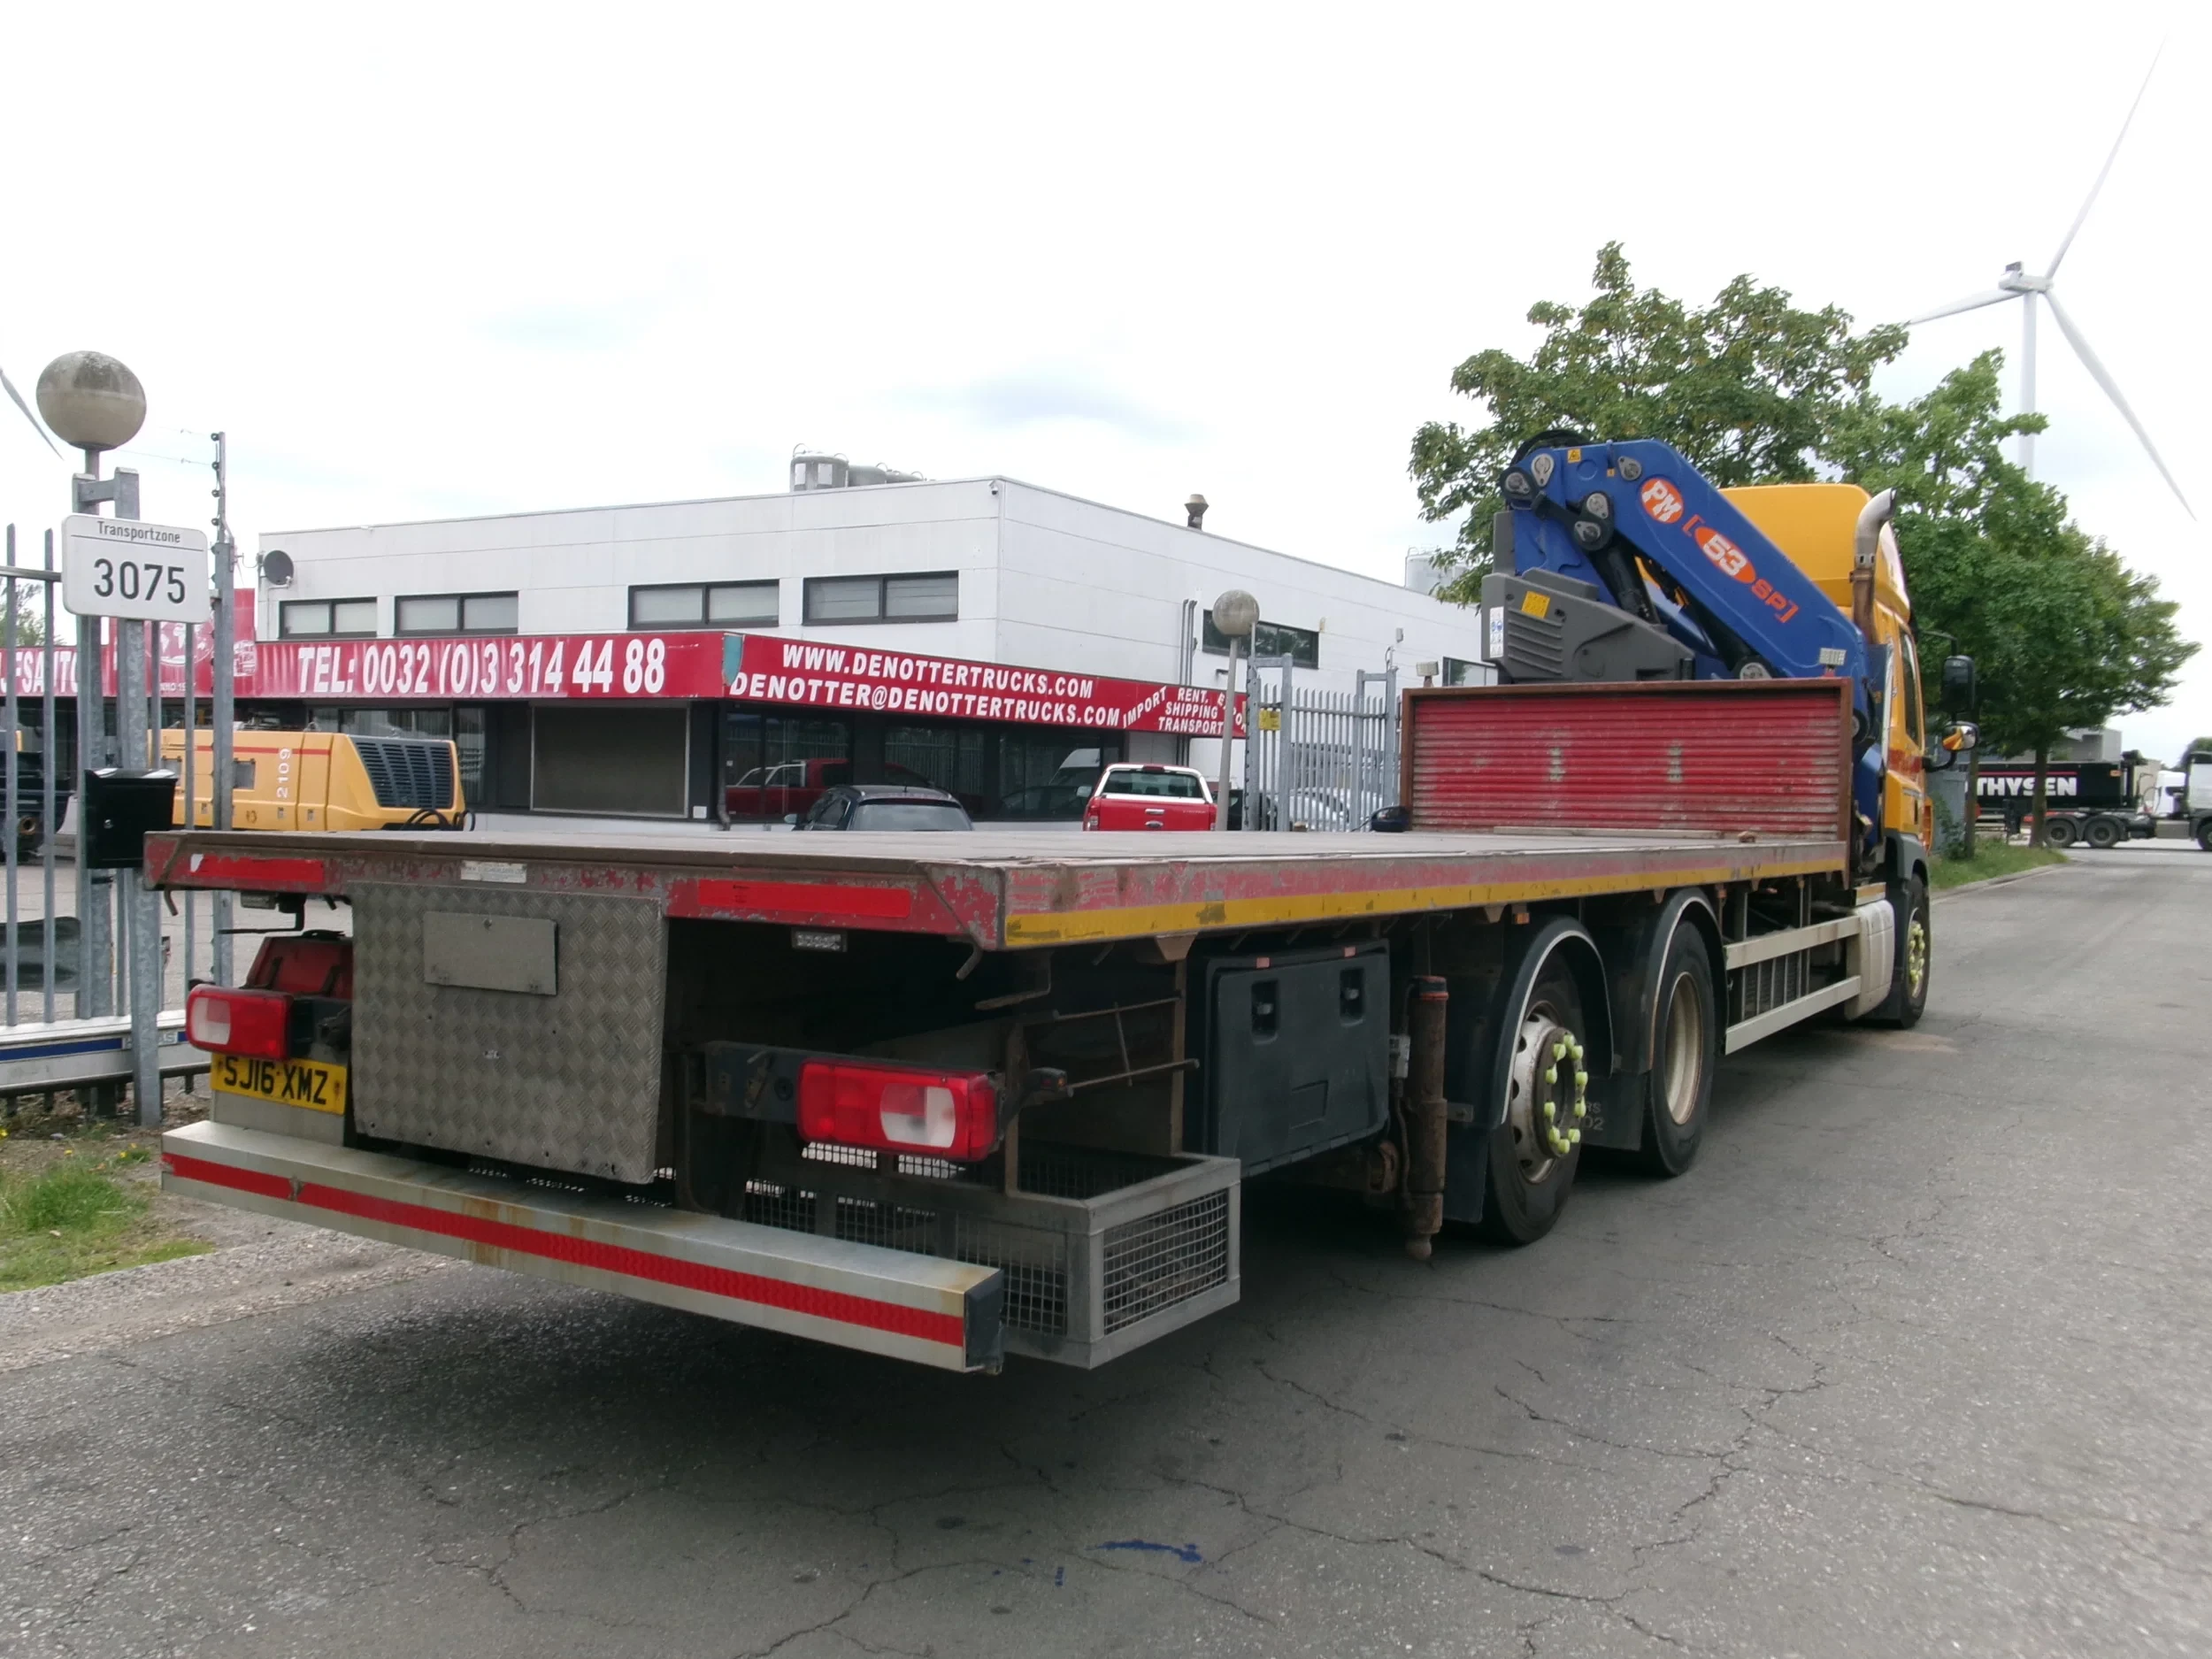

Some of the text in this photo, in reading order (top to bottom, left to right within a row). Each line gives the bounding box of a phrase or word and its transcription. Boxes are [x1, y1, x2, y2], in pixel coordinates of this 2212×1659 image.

[1641, 480, 1682, 522] PM
[97, 520, 180, 542] Transportzone
[94, 558, 185, 603] 3075
[294, 647, 355, 693] TEL:
[363, 644, 430, 694] 0032
[507, 641, 564, 694] 314
[572, 640, 613, 693] 44
[623, 638, 664, 694] 88
[783, 644, 1094, 698] WWW.DENOTTERTRUCKS.COM
[729, 672, 1120, 728] DENOTTER@DENOTTERTRUCKS.COM
[1123, 686, 1167, 729] IMPORT
[1165, 702, 1218, 719] SHIPPING
[1158, 717, 1225, 735] TRANSPORT
[276, 748, 291, 798] 2109
[224, 1056, 328, 1104] SJ16 XMZ
